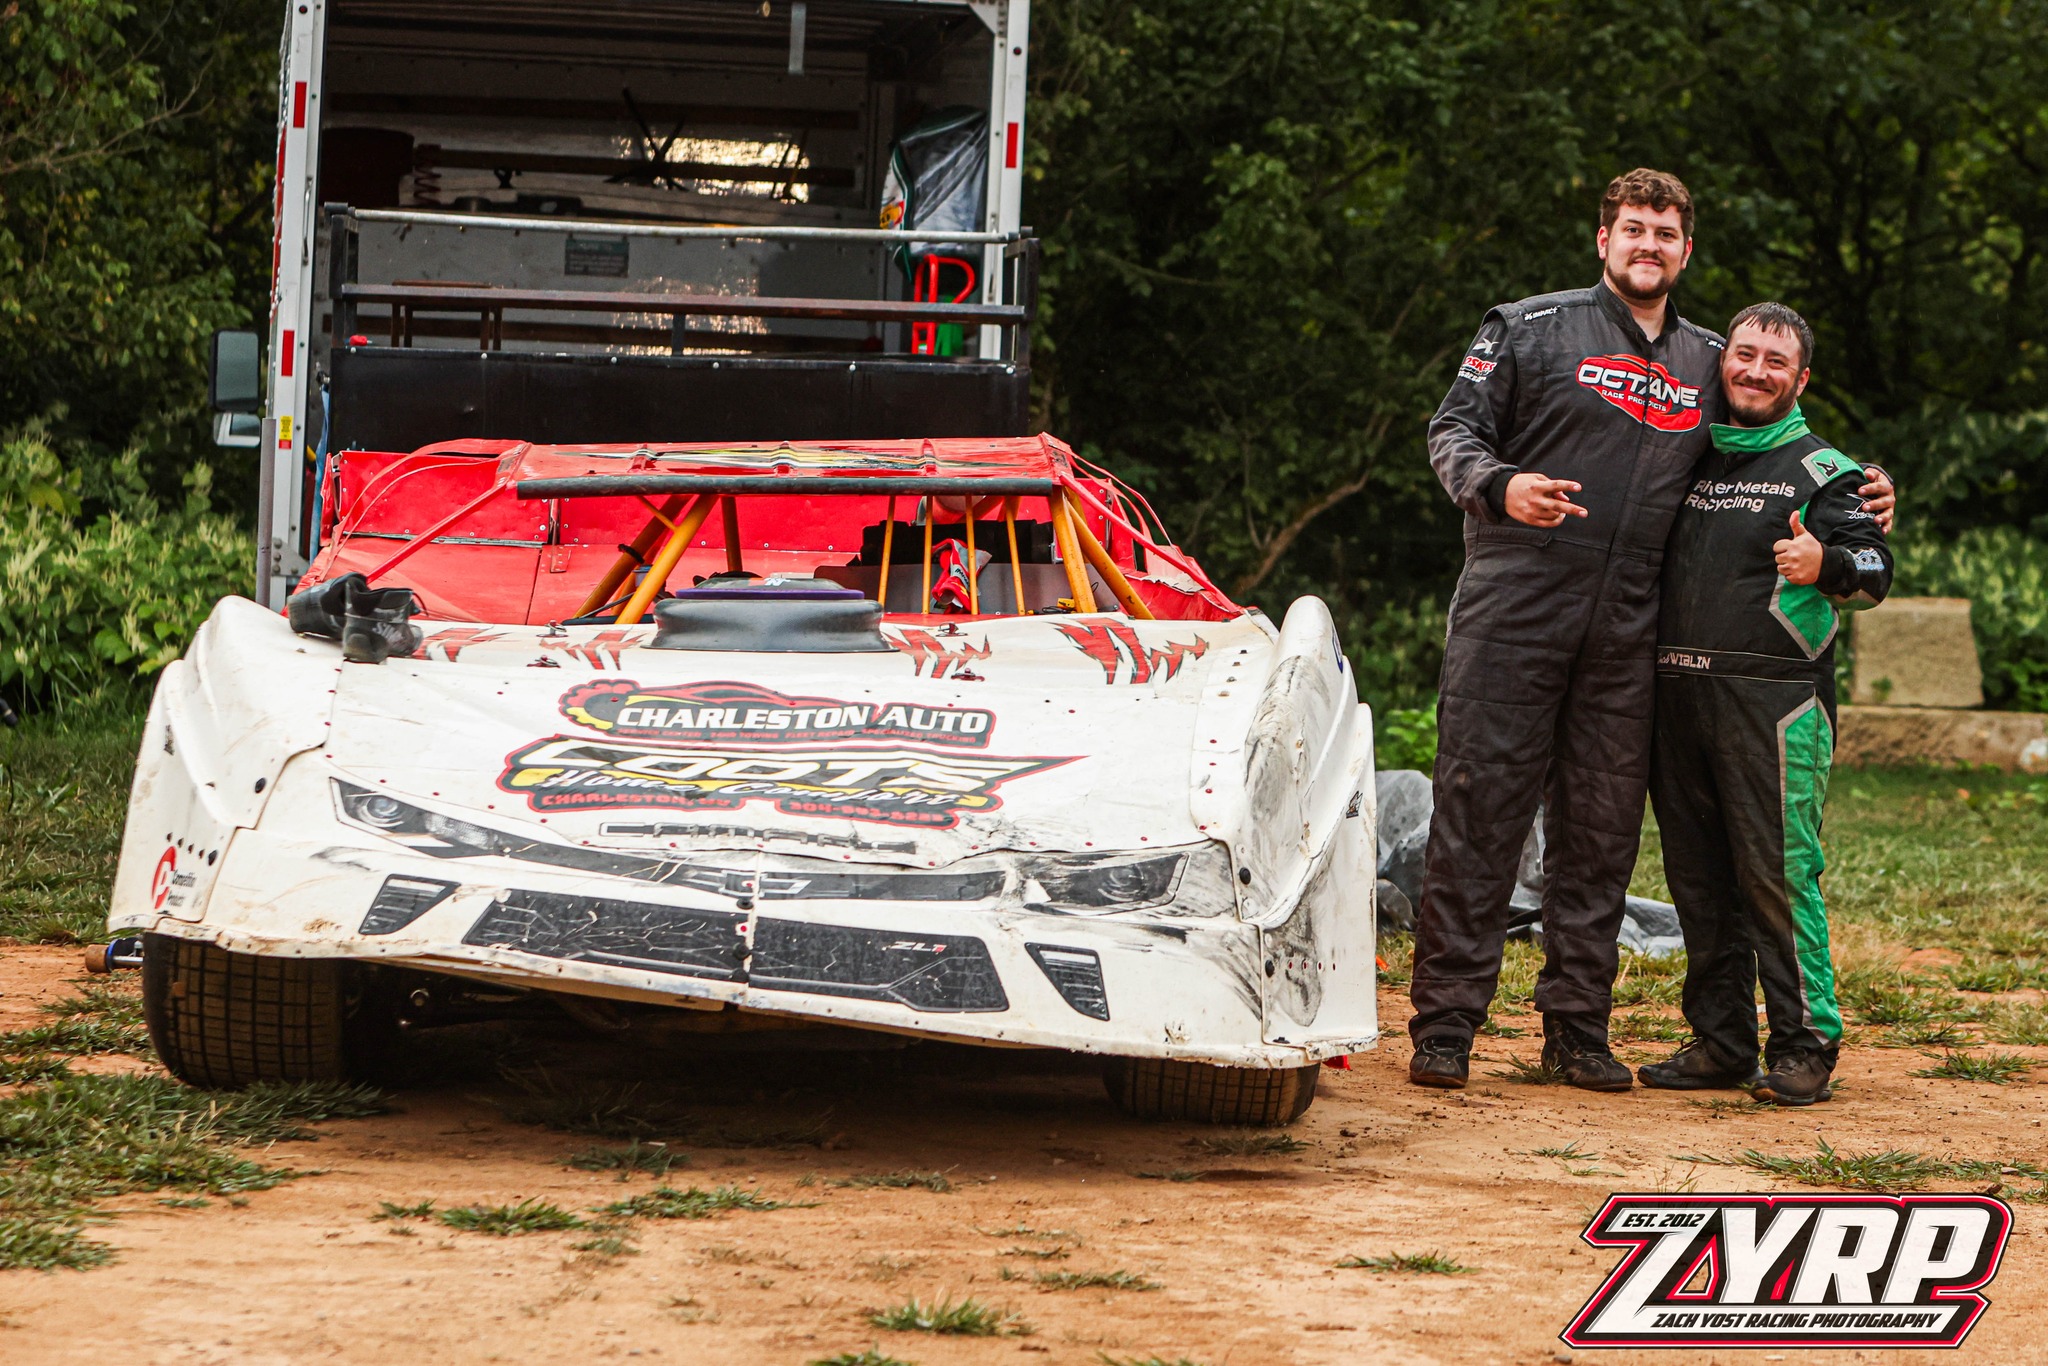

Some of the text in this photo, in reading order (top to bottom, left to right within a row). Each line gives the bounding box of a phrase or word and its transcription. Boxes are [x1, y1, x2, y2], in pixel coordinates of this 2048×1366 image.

[1578, 364, 1701, 408] OCTANE
[1602, 389, 1625, 400] RACE
[1734, 481, 1796, 498] Metals
[1685, 494, 1765, 512] Recycling
[616, 705, 989, 734] CHARLESTON AUTO
[534, 769, 962, 806] Home Comfort
[889, 940, 948, 955] ZL1
